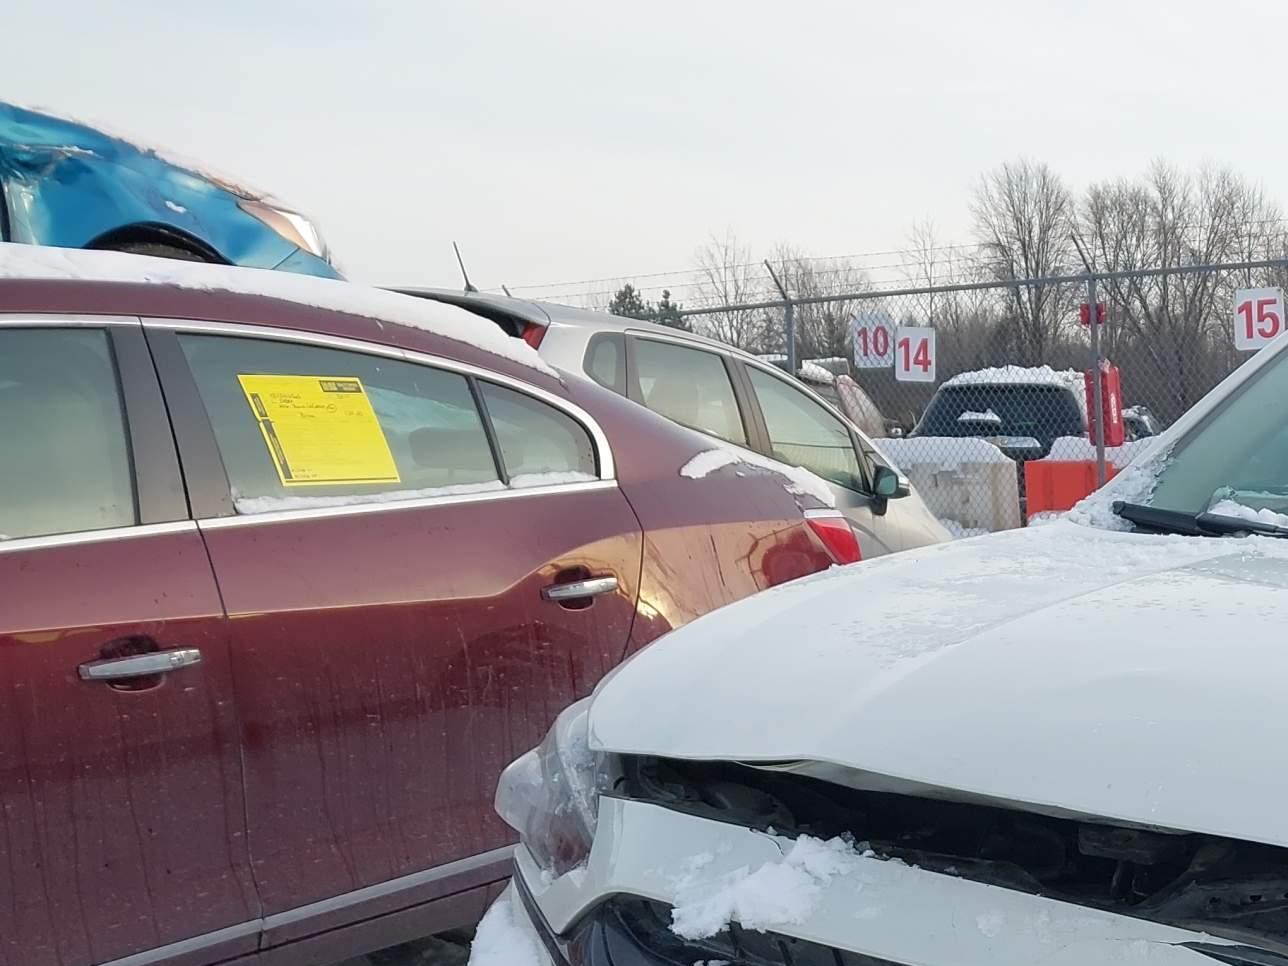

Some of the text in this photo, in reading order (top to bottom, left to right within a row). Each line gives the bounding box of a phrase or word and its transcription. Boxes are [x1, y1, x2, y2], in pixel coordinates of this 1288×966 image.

[1237, 298, 1280, 339] 15
[858, 325, 889, 357] 10
[898, 336, 932, 372] 14
